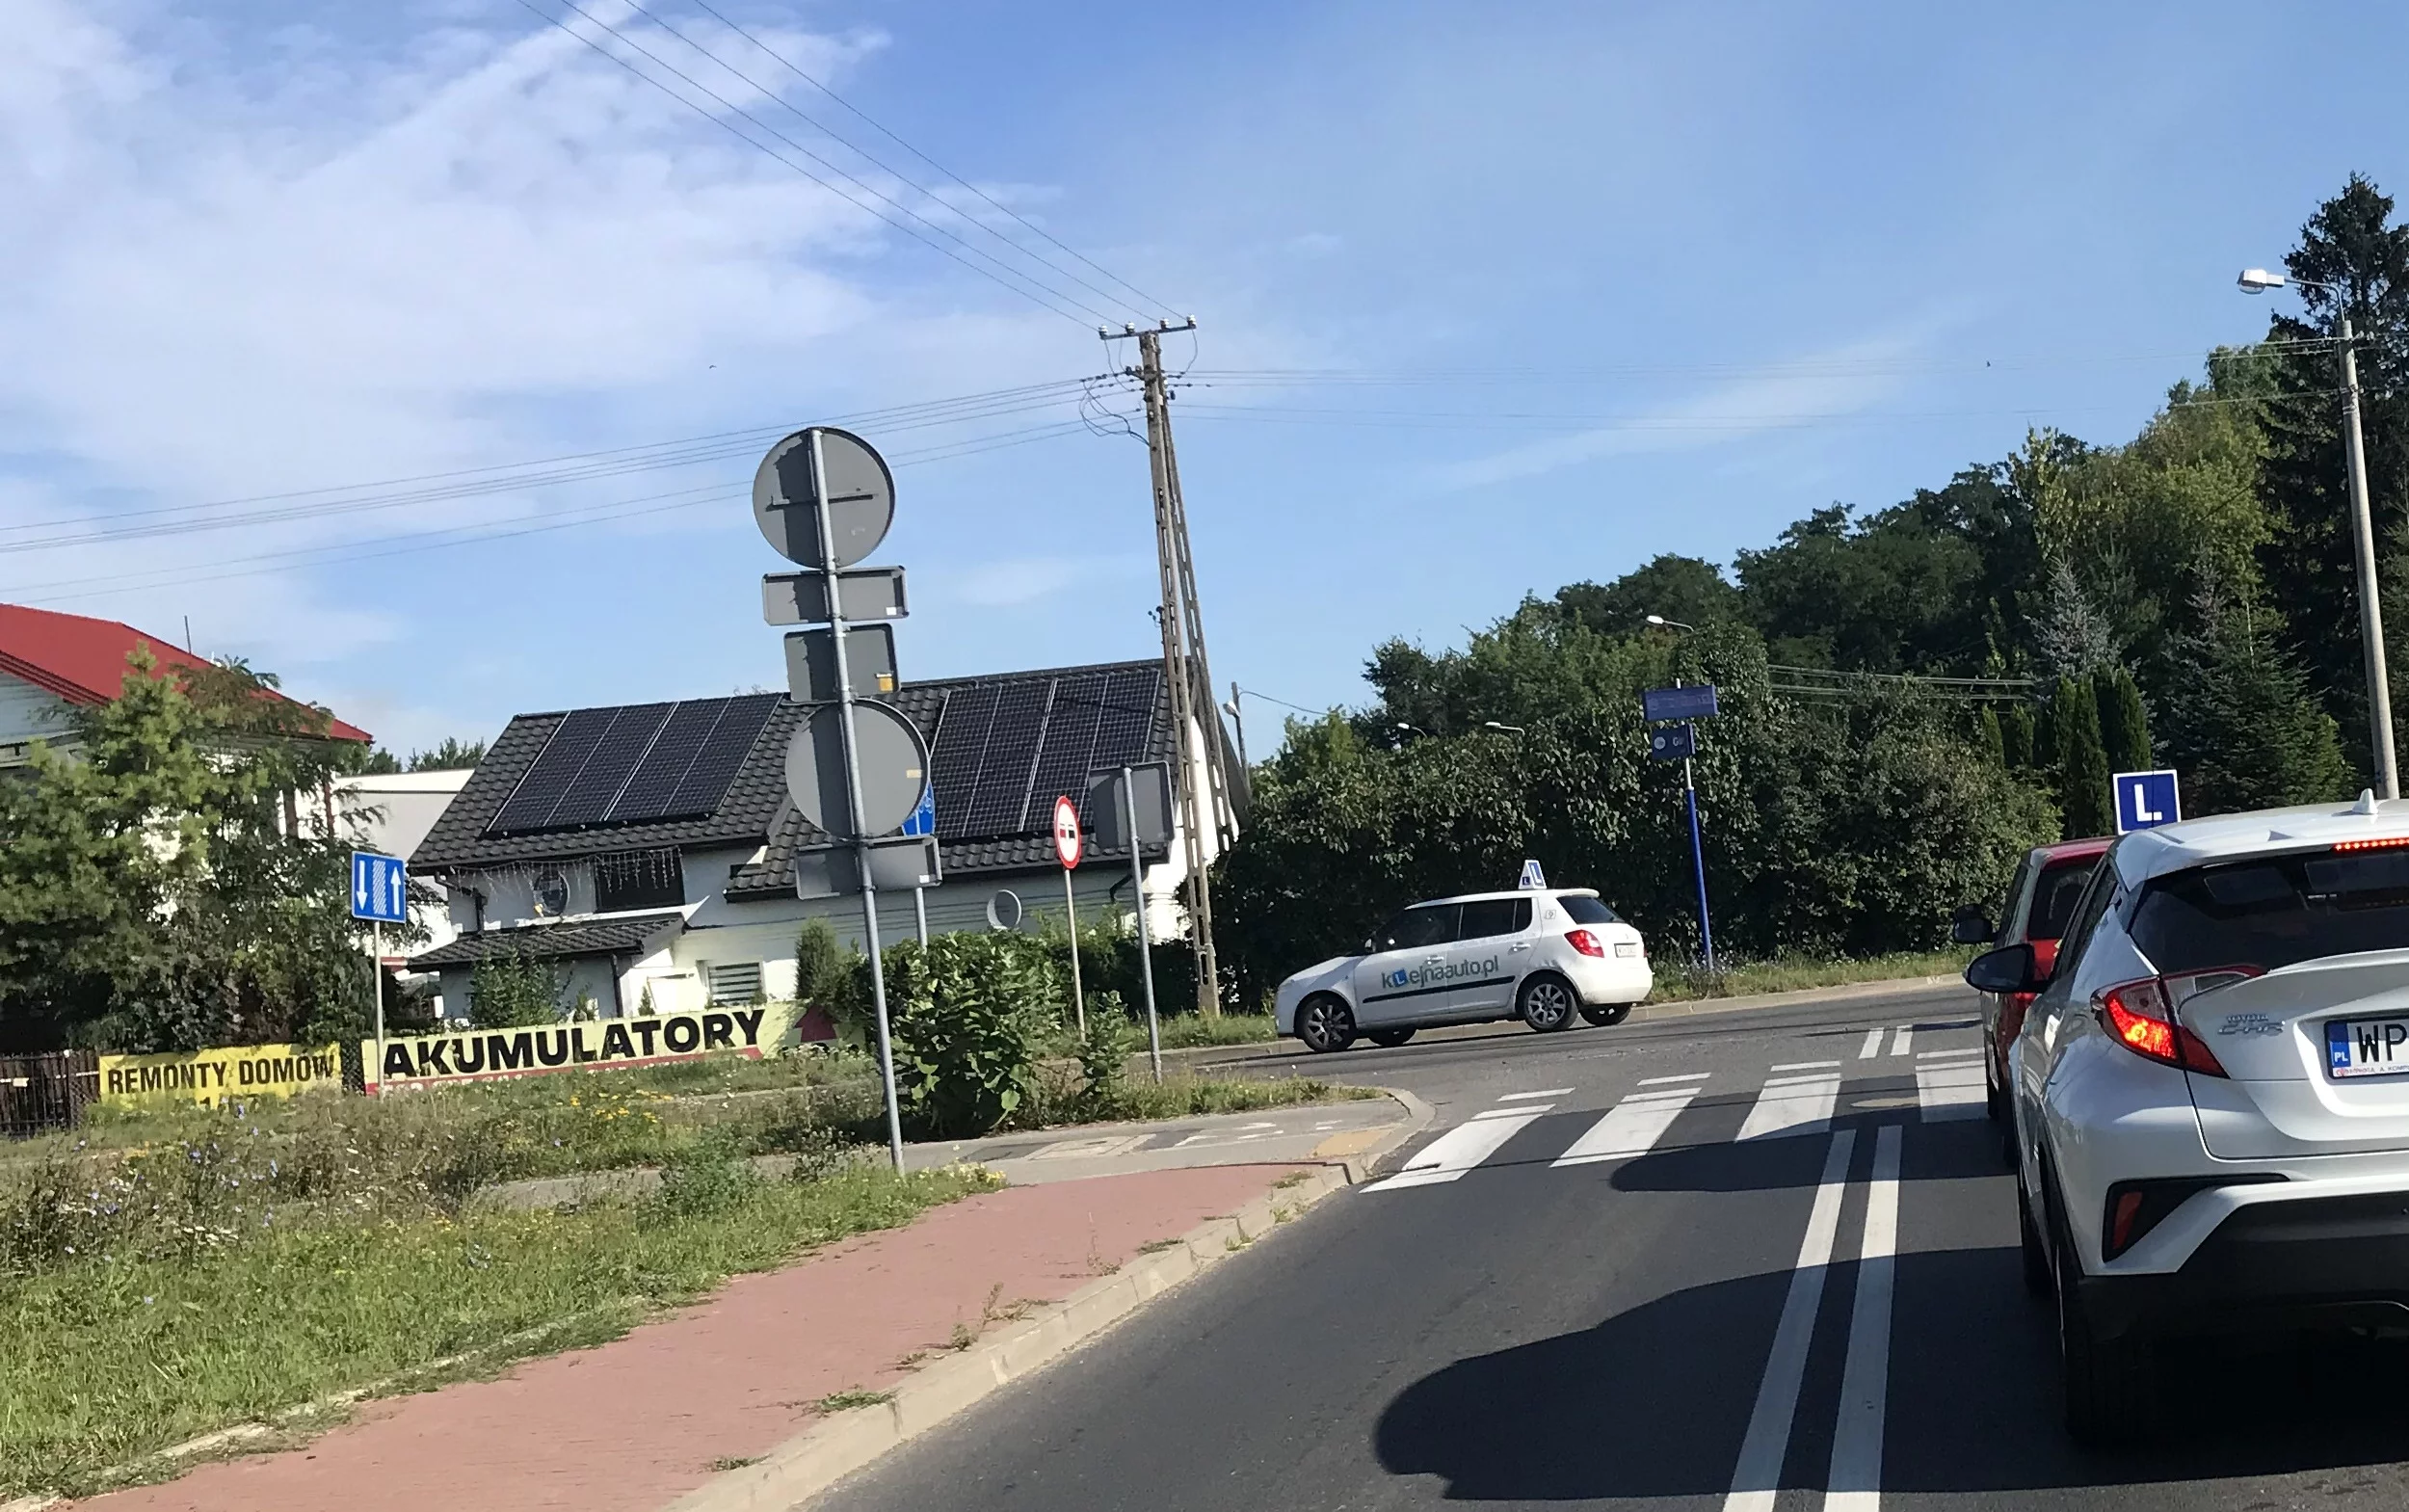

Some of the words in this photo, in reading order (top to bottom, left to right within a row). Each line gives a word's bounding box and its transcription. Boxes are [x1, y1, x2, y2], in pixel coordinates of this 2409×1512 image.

[2133, 783, 2162, 822] L
[1530, 864, 1543, 884] L
[384, 1007, 766, 1079] AKUMULATORY
[2334, 1051, 2349, 1063] PL
[108, 1061, 227, 1095] REMONTY
[239, 1044, 334, 1086] DOMÓW
